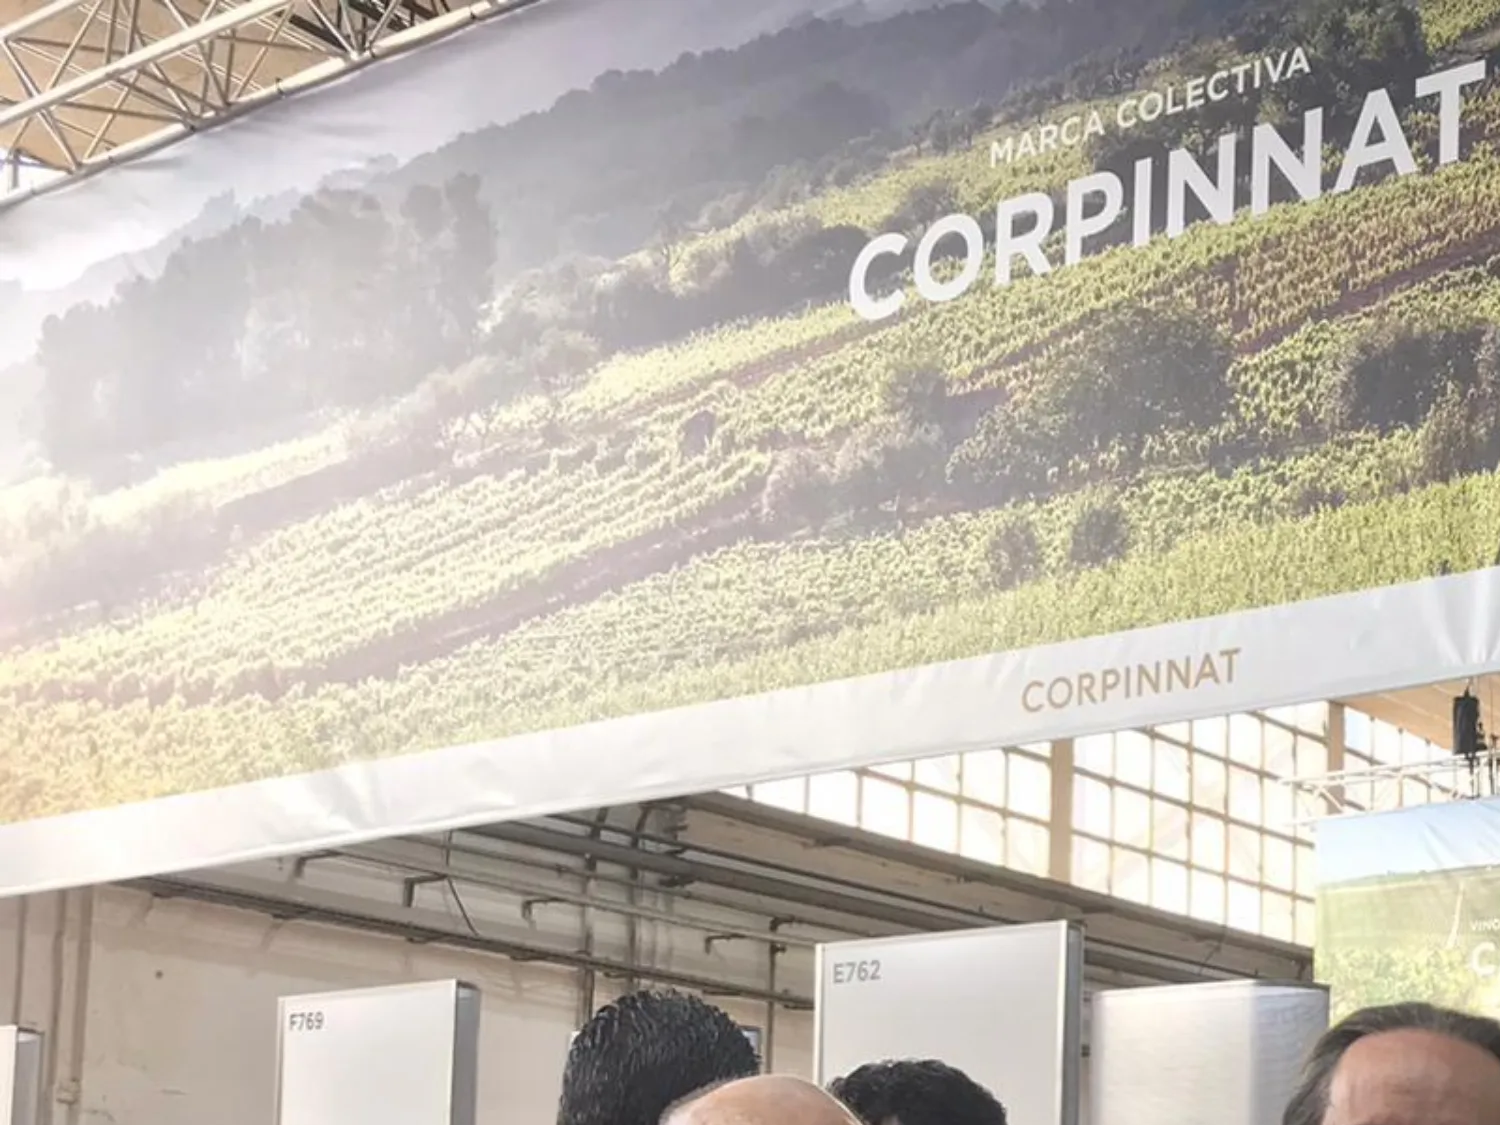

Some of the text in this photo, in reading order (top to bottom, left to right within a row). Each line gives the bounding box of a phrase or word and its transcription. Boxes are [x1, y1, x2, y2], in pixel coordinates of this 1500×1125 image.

[989, 46, 1311, 169] MARCA COLECTIVA
[849, 60, 1486, 322] CORPINNAT
[1021, 647, 1241, 713] CORPINNAT
[833, 959, 882, 984] E762
[289, 1012, 325, 1031] F769
